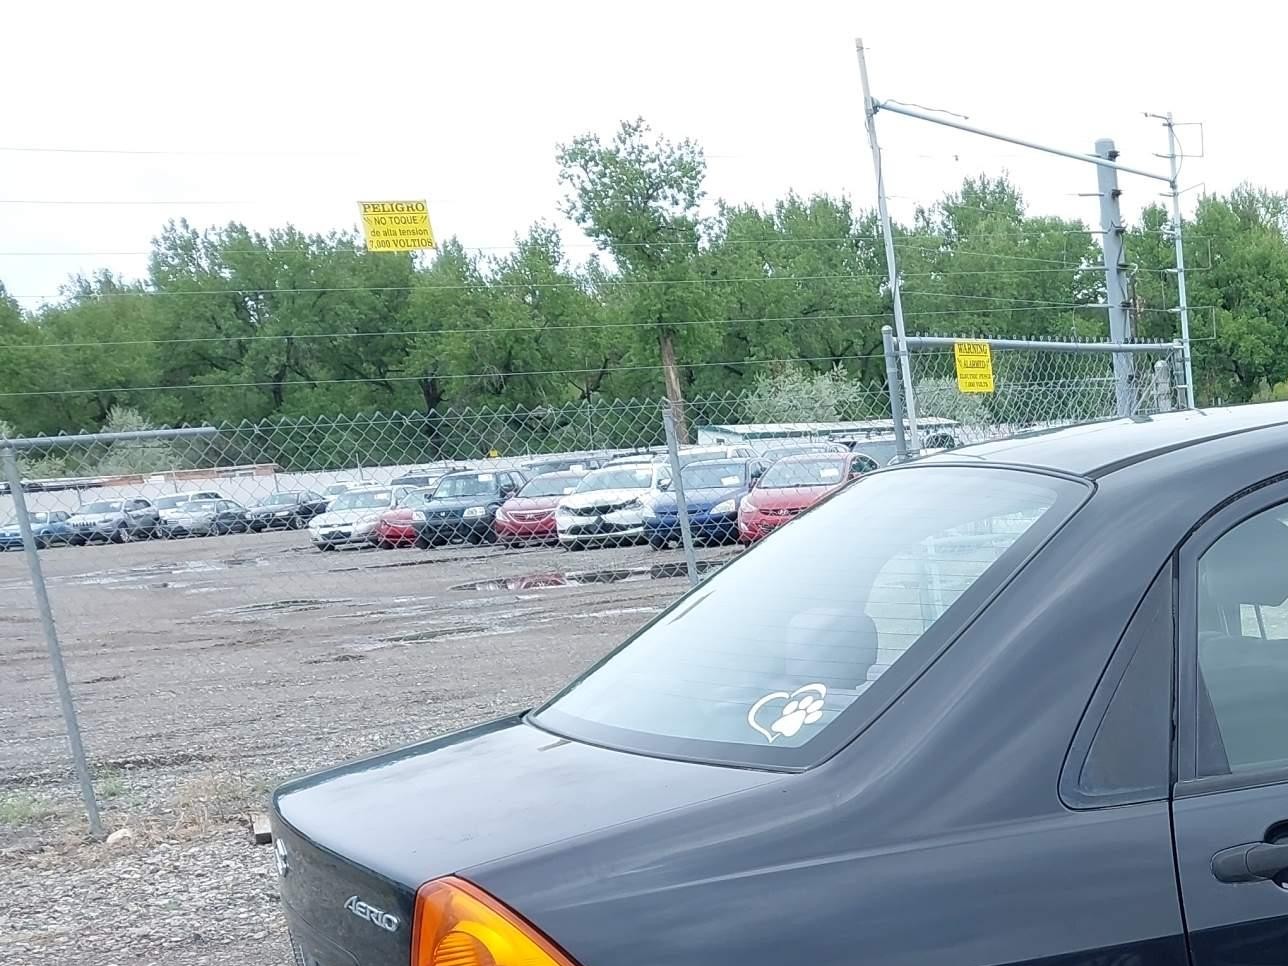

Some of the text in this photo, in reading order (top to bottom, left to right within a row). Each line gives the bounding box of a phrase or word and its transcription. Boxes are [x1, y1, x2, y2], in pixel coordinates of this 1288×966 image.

[362, 202, 425, 213] PELIGRO
[374, 215, 418, 226] NO TOQUE
[370, 228, 381, 237] de
[383, 228, 398, 237] alta
[392, 238, 433, 248] VOLTIOS
[957, 343, 988, 354] WARNING
[344, 895, 398, 931] AERIO
